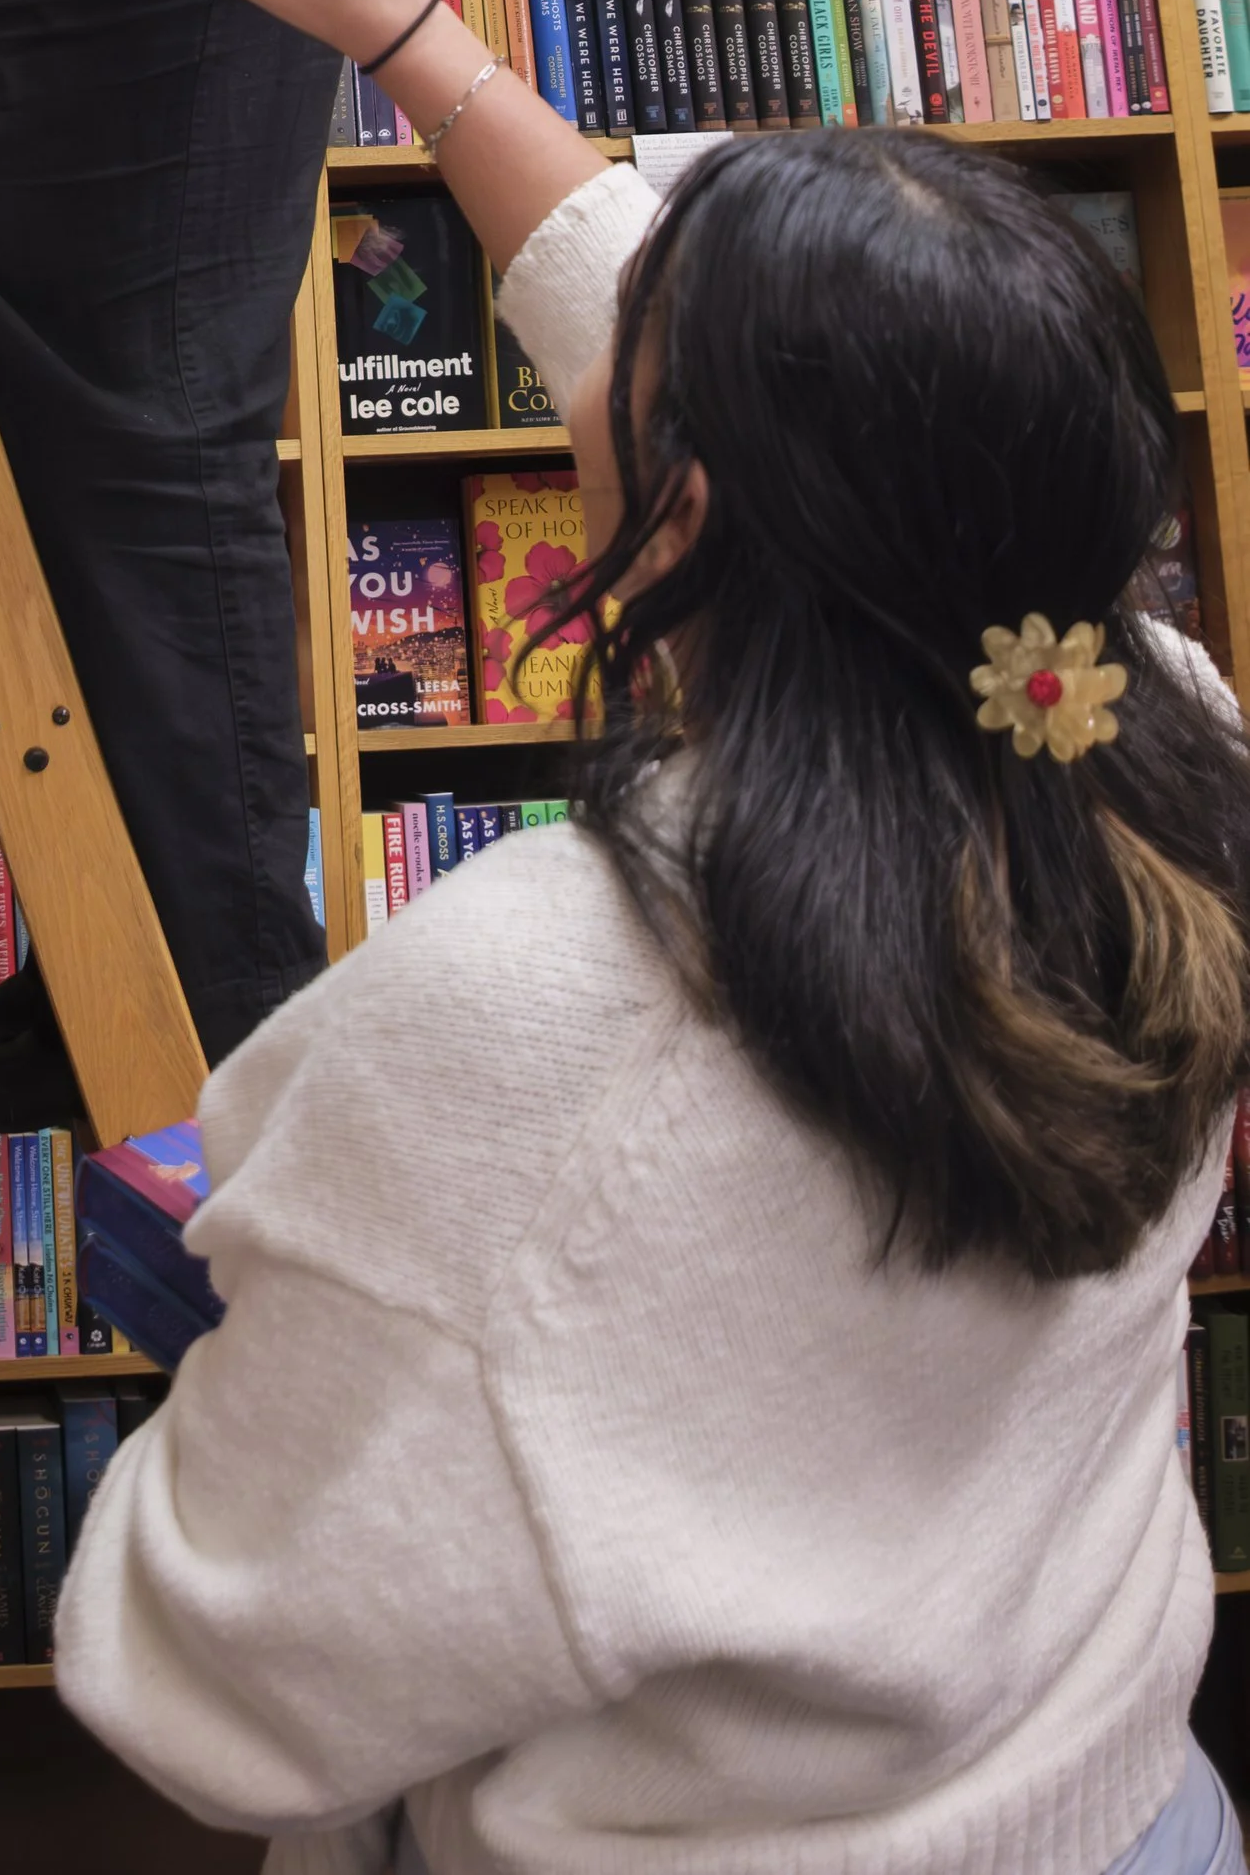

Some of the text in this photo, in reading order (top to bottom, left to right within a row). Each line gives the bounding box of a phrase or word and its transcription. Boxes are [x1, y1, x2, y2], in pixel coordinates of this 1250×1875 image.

[574, 2, 586, 23] WE
[605, 0, 616, 20] WE
[577, 27, 590, 66] WERE
[608, 24, 621, 63] WERE
[635, 37, 647, 81] COSMOS
[643, 23, 660, 94] CHRISTOPHER
[664, 39, 677, 83] COSMOS
[673, 25, 689, 95] CHRISTOPHER
[693, 37, 706, 82] COSMOS
[702, 24, 717, 94] CHRISTOPHER
[758, 34, 771, 78] COSMOS
[766, 21, 782, 91] CHRISTOPHER
[816, 33, 834, 69] GIRLS
[922, 30, 941, 78] DEVIL
[1196, 8, 1214, 79] DAUGHTER
[1210, 9, 1227, 77] FAVORITE
[581, 70, 594, 106] HERE
[612, 67, 625, 103] HERE
[350, 390, 460, 420] lee cole
[384, 382, 422, 396] A Novel
[486, 496, 549, 517] SPEAK
[505, 521, 533, 540] OF
[489, 588, 500, 625] A Novel
[416, 679, 461, 694] LEESA
[357, 699, 462, 717] CROSS-SMITH
[386, 817, 407, 911] FIRE RUSH
